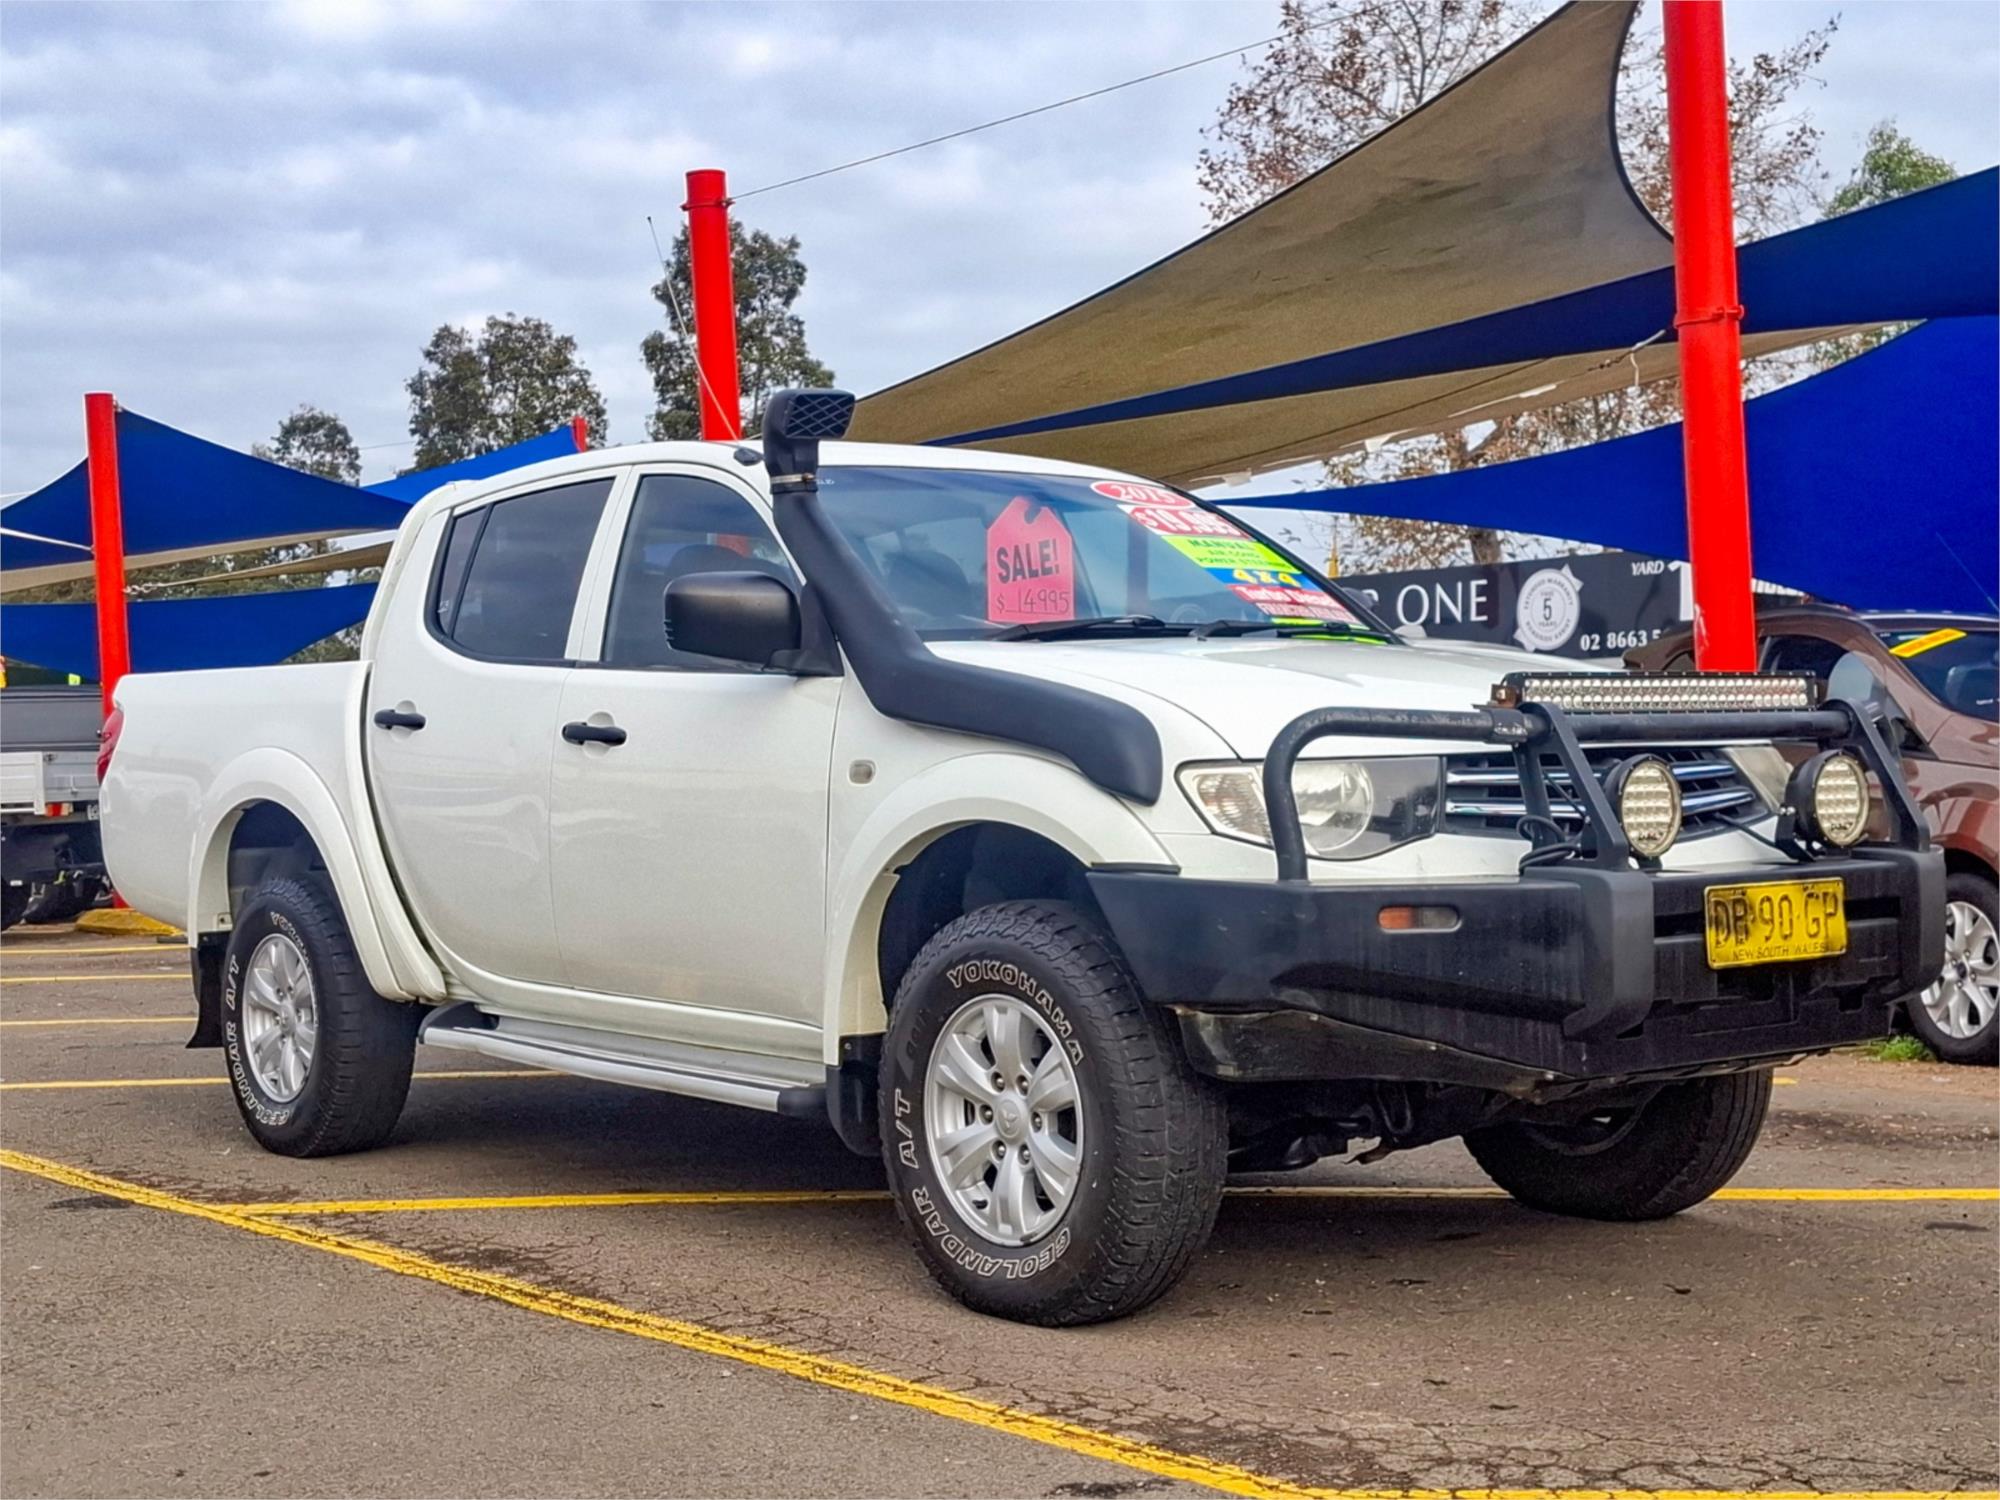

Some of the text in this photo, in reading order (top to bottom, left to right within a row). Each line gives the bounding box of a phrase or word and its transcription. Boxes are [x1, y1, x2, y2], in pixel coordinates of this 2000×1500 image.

[997, 538, 1060, 584] SALE!
[1631, 560, 1665, 576] YARD
[1396, 579, 1488, 625] ONE
[1543, 598, 1552, 621] 5
[1580, 633, 1600, 651] 02
[1606, 630, 1648, 649] 8663
[1733, 948, 1754, 961] NEW
[1757, 945, 1789, 959] SOUTH
[947, 960, 1084, 1066] YOKOHAMA
[895, 1089, 1071, 1279] GEOLANDAR A/T
